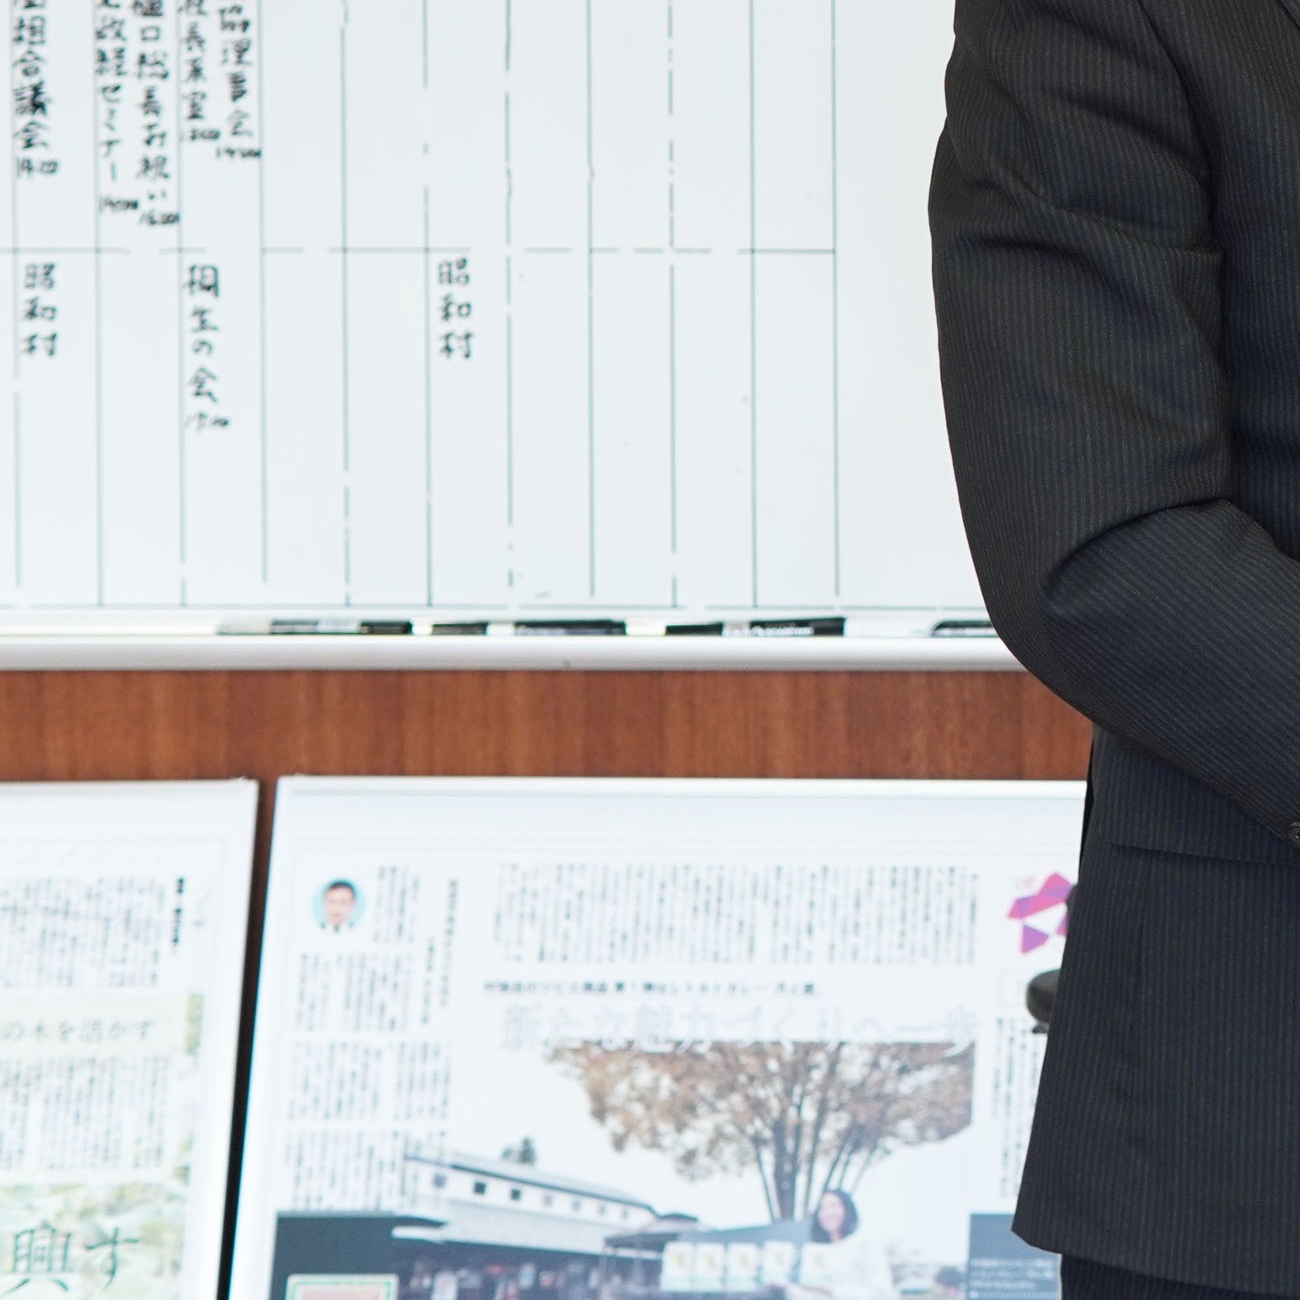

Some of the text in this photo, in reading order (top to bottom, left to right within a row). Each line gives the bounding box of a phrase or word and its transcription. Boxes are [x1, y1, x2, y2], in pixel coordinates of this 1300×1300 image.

[22, 262, 58, 357] 昭和村
[438, 259, 472, 360] 昭和村
